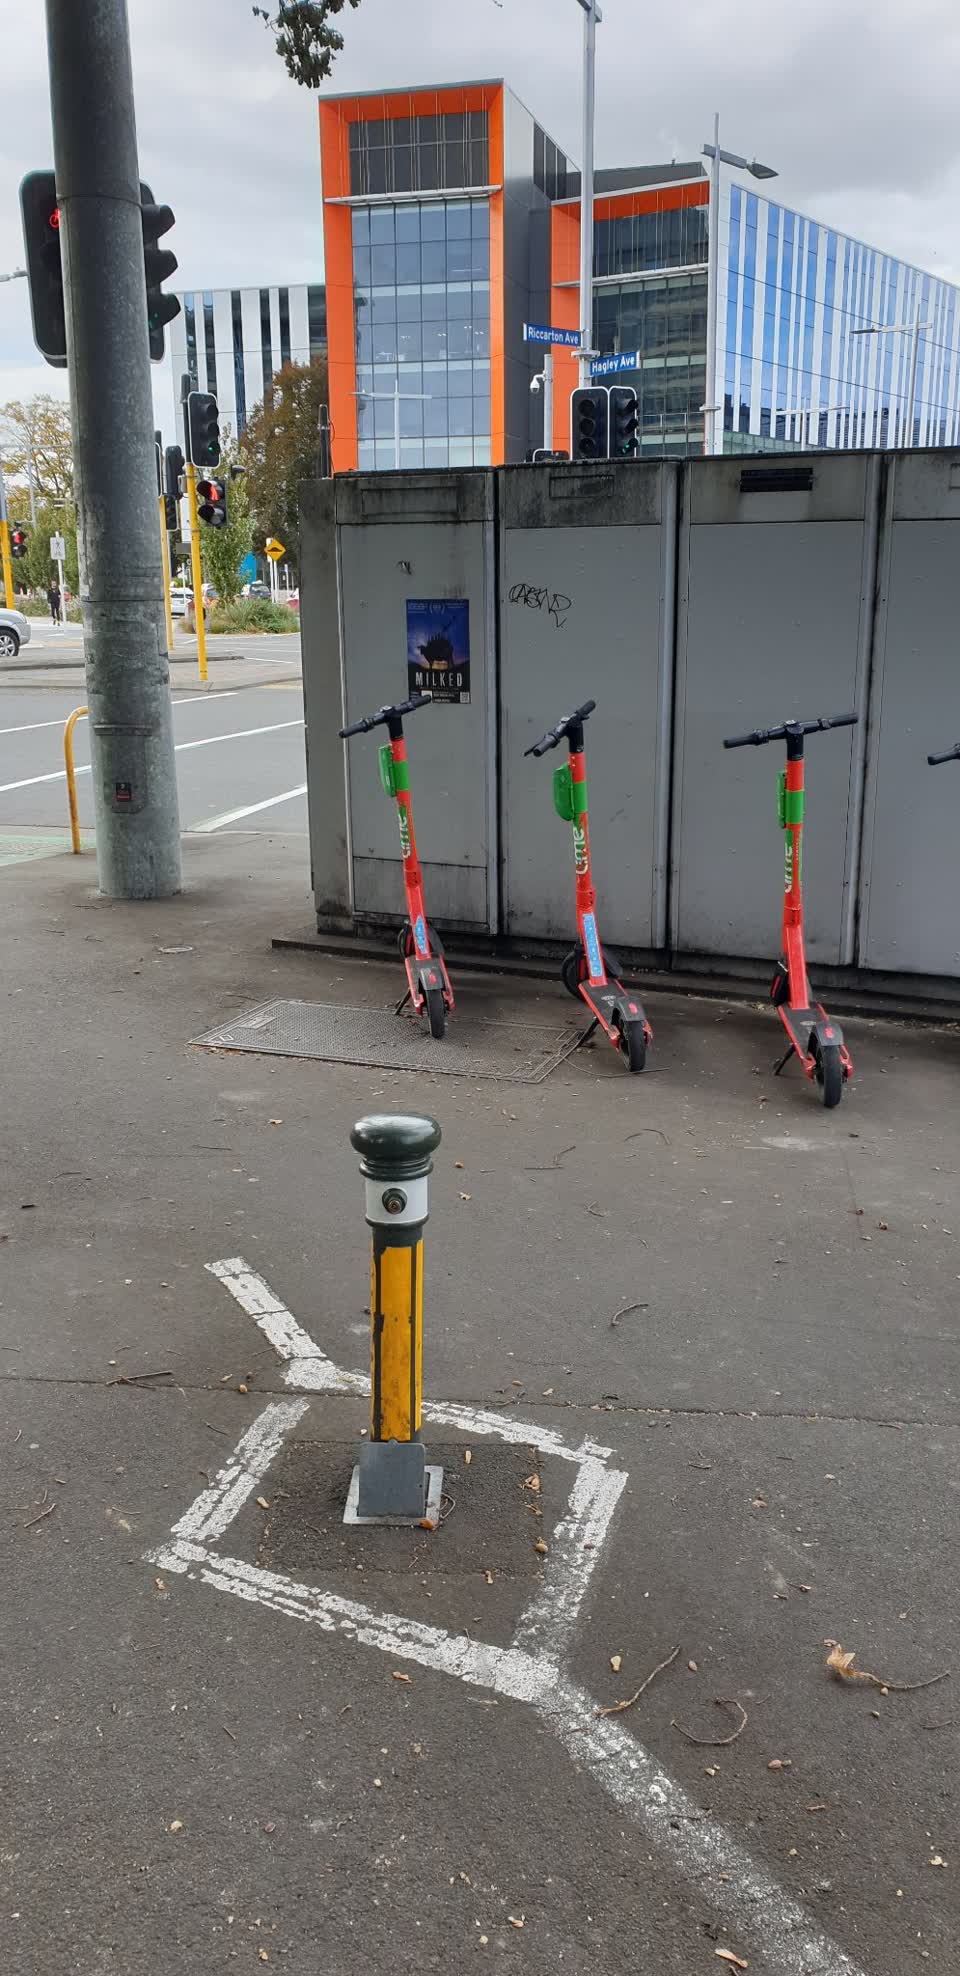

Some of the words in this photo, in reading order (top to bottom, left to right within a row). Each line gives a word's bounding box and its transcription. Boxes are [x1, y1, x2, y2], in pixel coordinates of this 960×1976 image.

[528, 326, 563, 343] Riccarton
[565, 332, 579, 345] Ave
[592, 358, 618, 375] Hagley
[620, 355, 635, 368] Ave
[415, 671, 463, 688] MILKED
